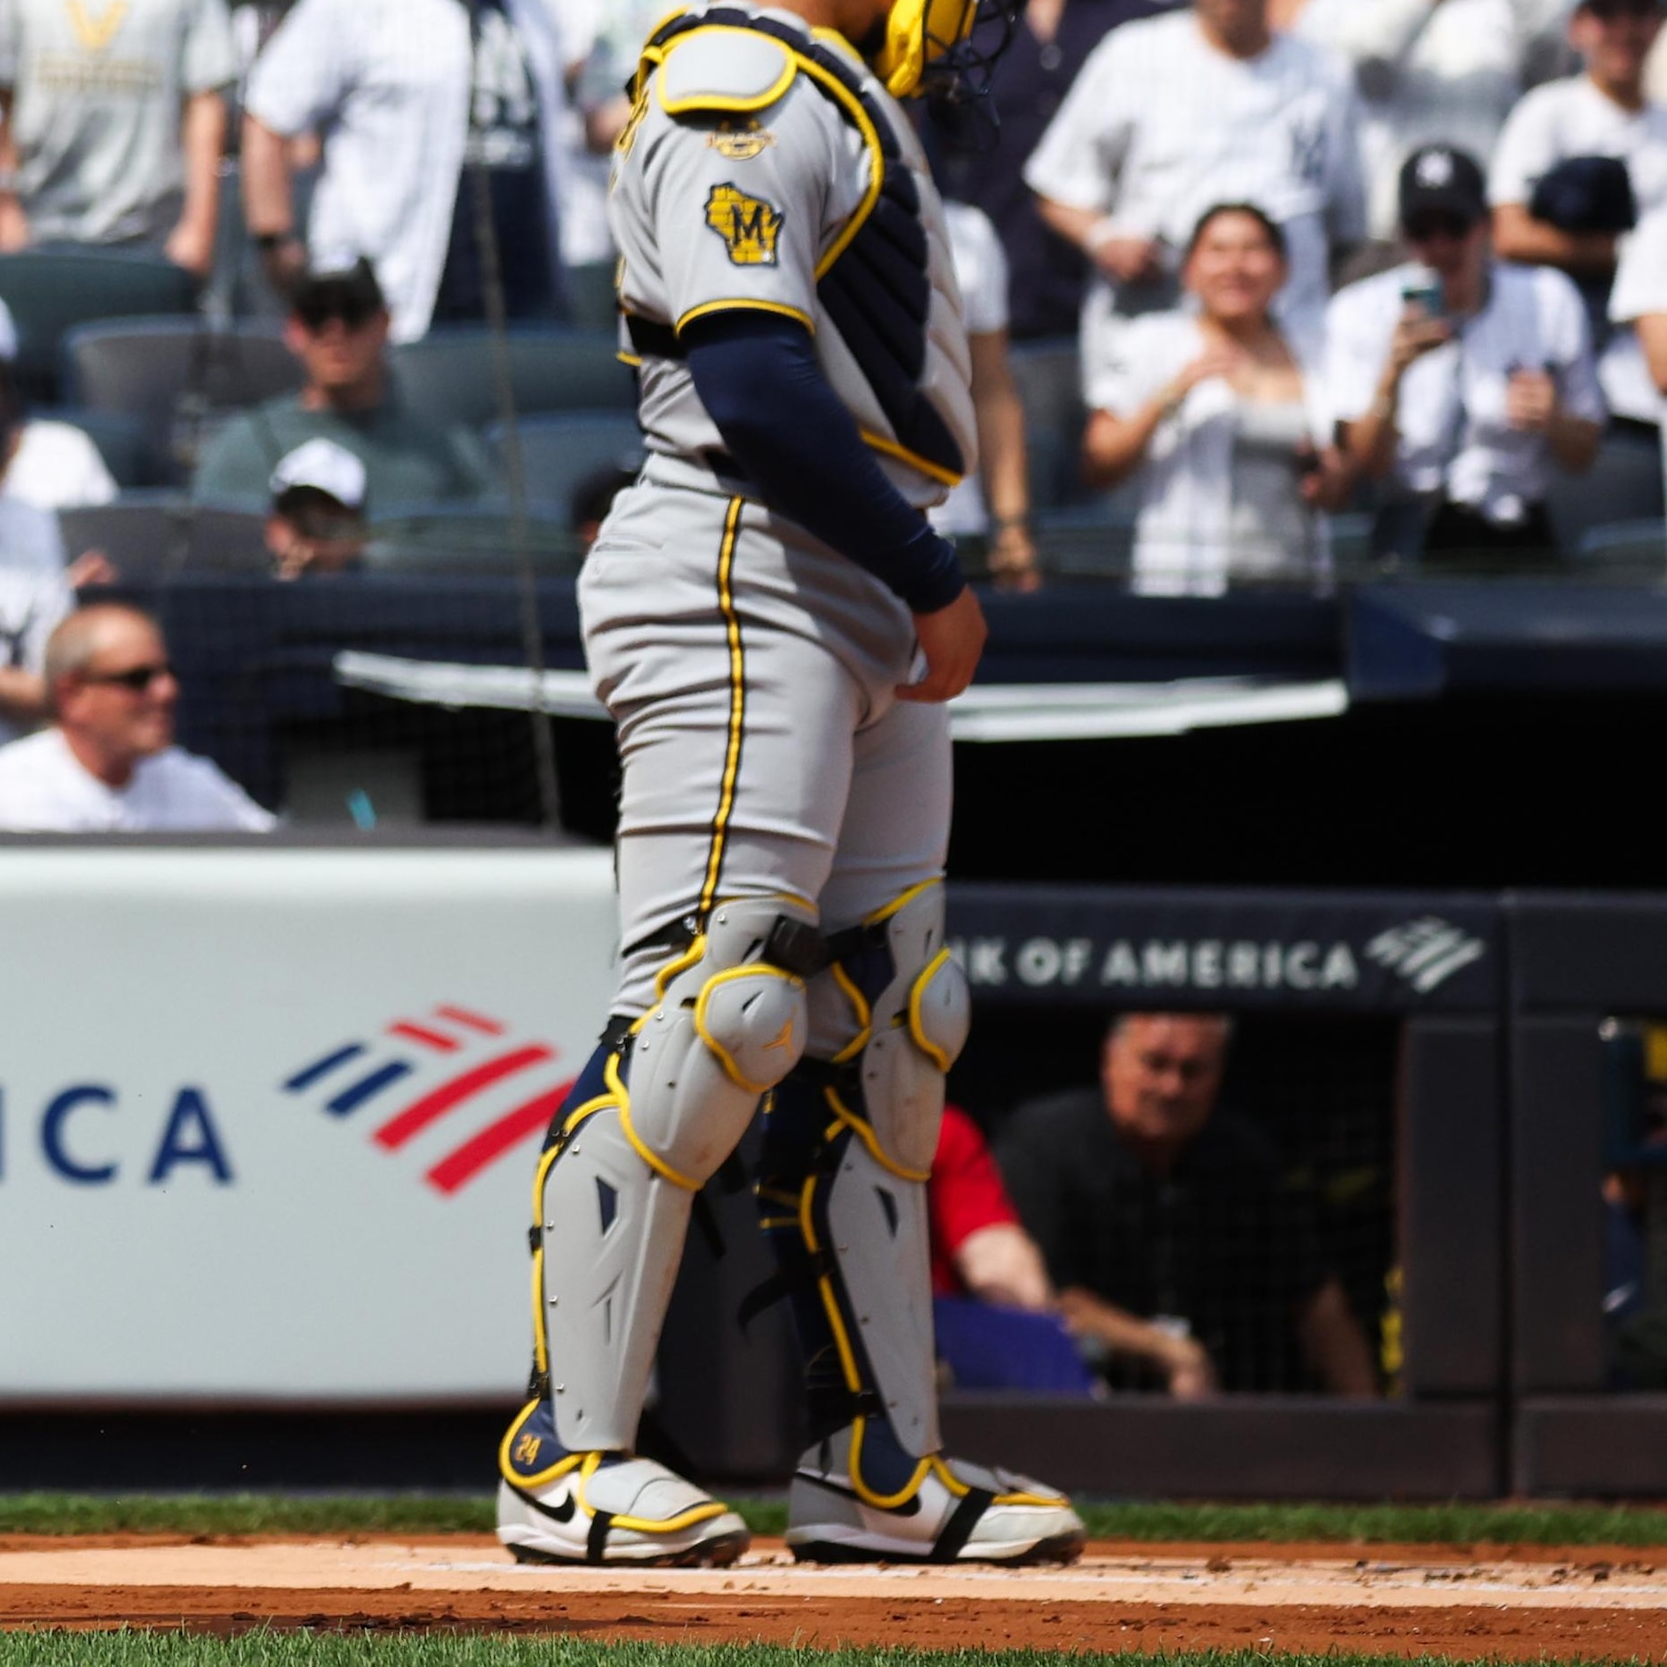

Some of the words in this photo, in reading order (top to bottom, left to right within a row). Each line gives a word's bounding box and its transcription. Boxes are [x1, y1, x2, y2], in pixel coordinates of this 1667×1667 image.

[730, 203, 766, 249] M
[1016, 936, 1092, 988] OF
[1100, 936, 1359, 990] AMERICA
[514, 1433, 543, 1466] 24
